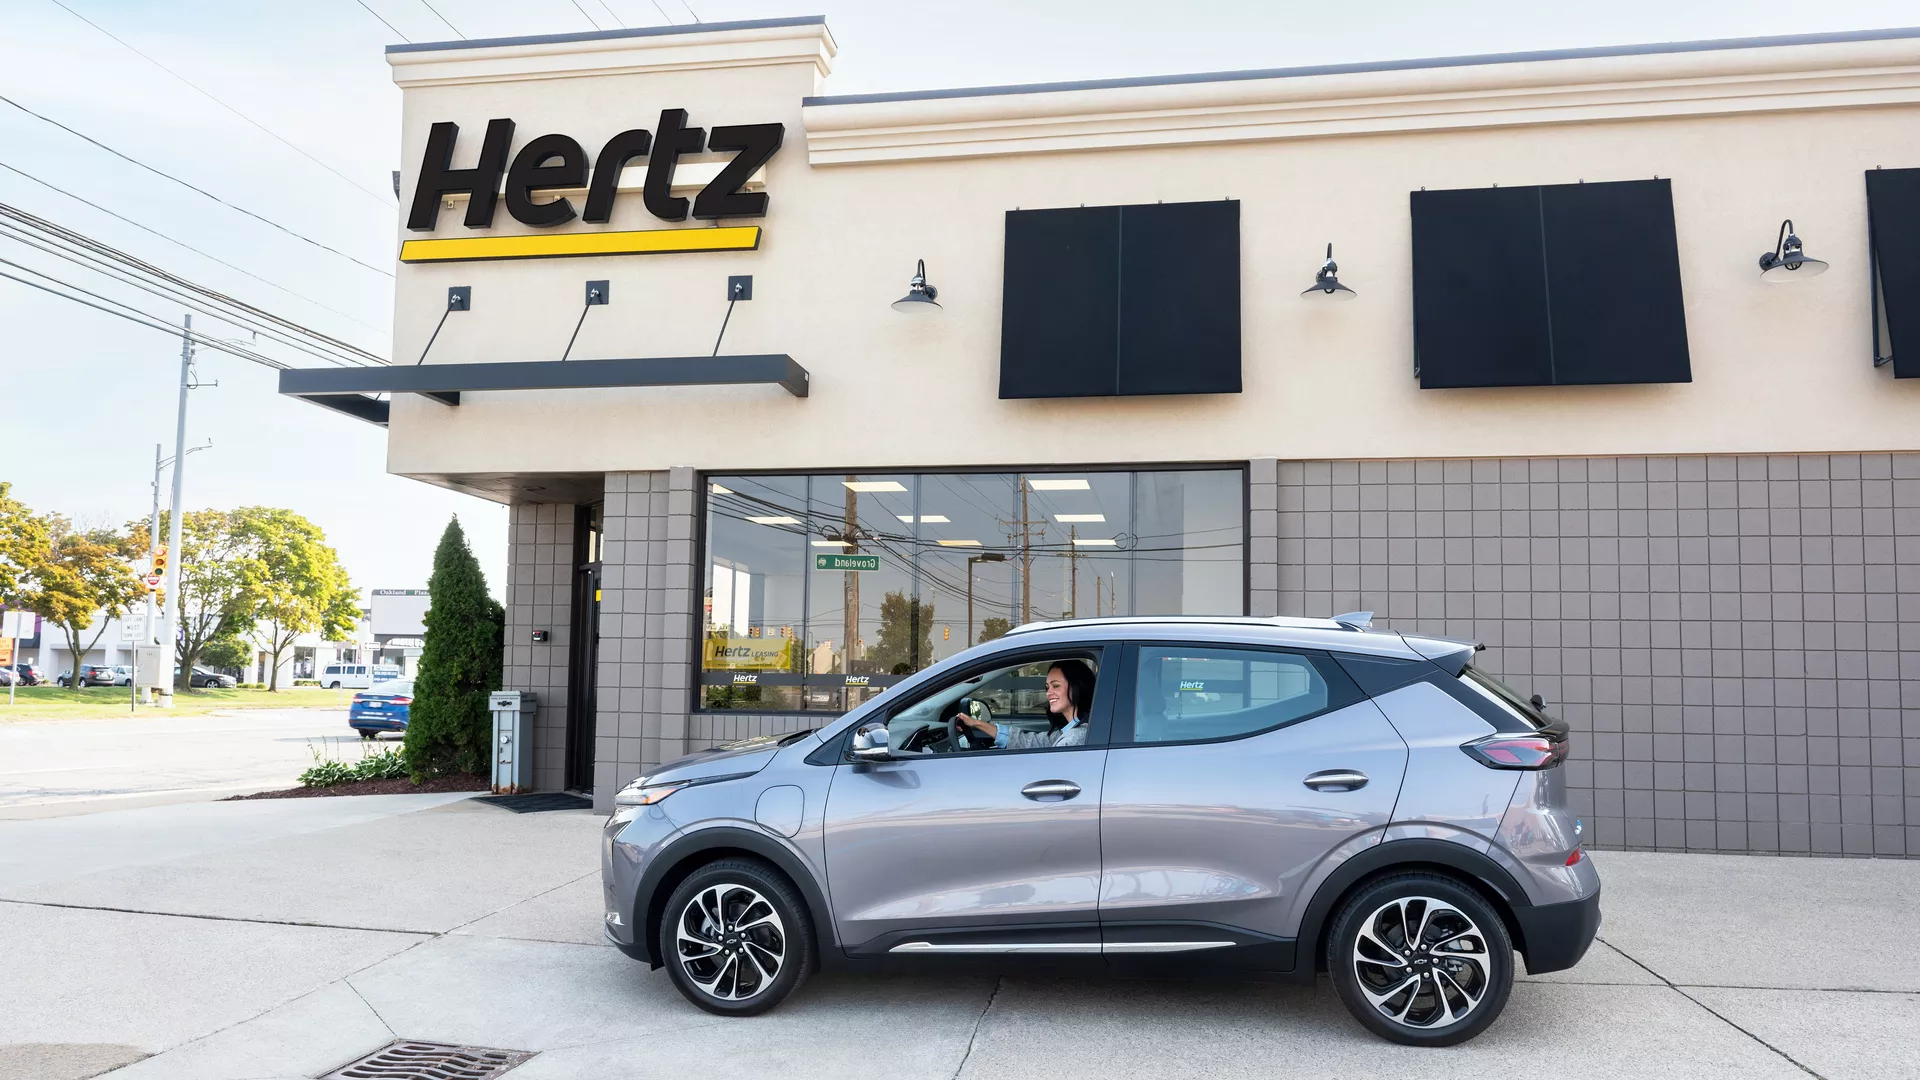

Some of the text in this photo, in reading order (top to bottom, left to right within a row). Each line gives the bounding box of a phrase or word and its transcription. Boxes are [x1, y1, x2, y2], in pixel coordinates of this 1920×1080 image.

[407, 108, 785, 231] Hertz
[715, 646, 751, 657] Hertz
[733, 674, 758, 682] Hertz
[845, 675, 870, 683] Hertz
[1180, 681, 1204, 689] Hertz
